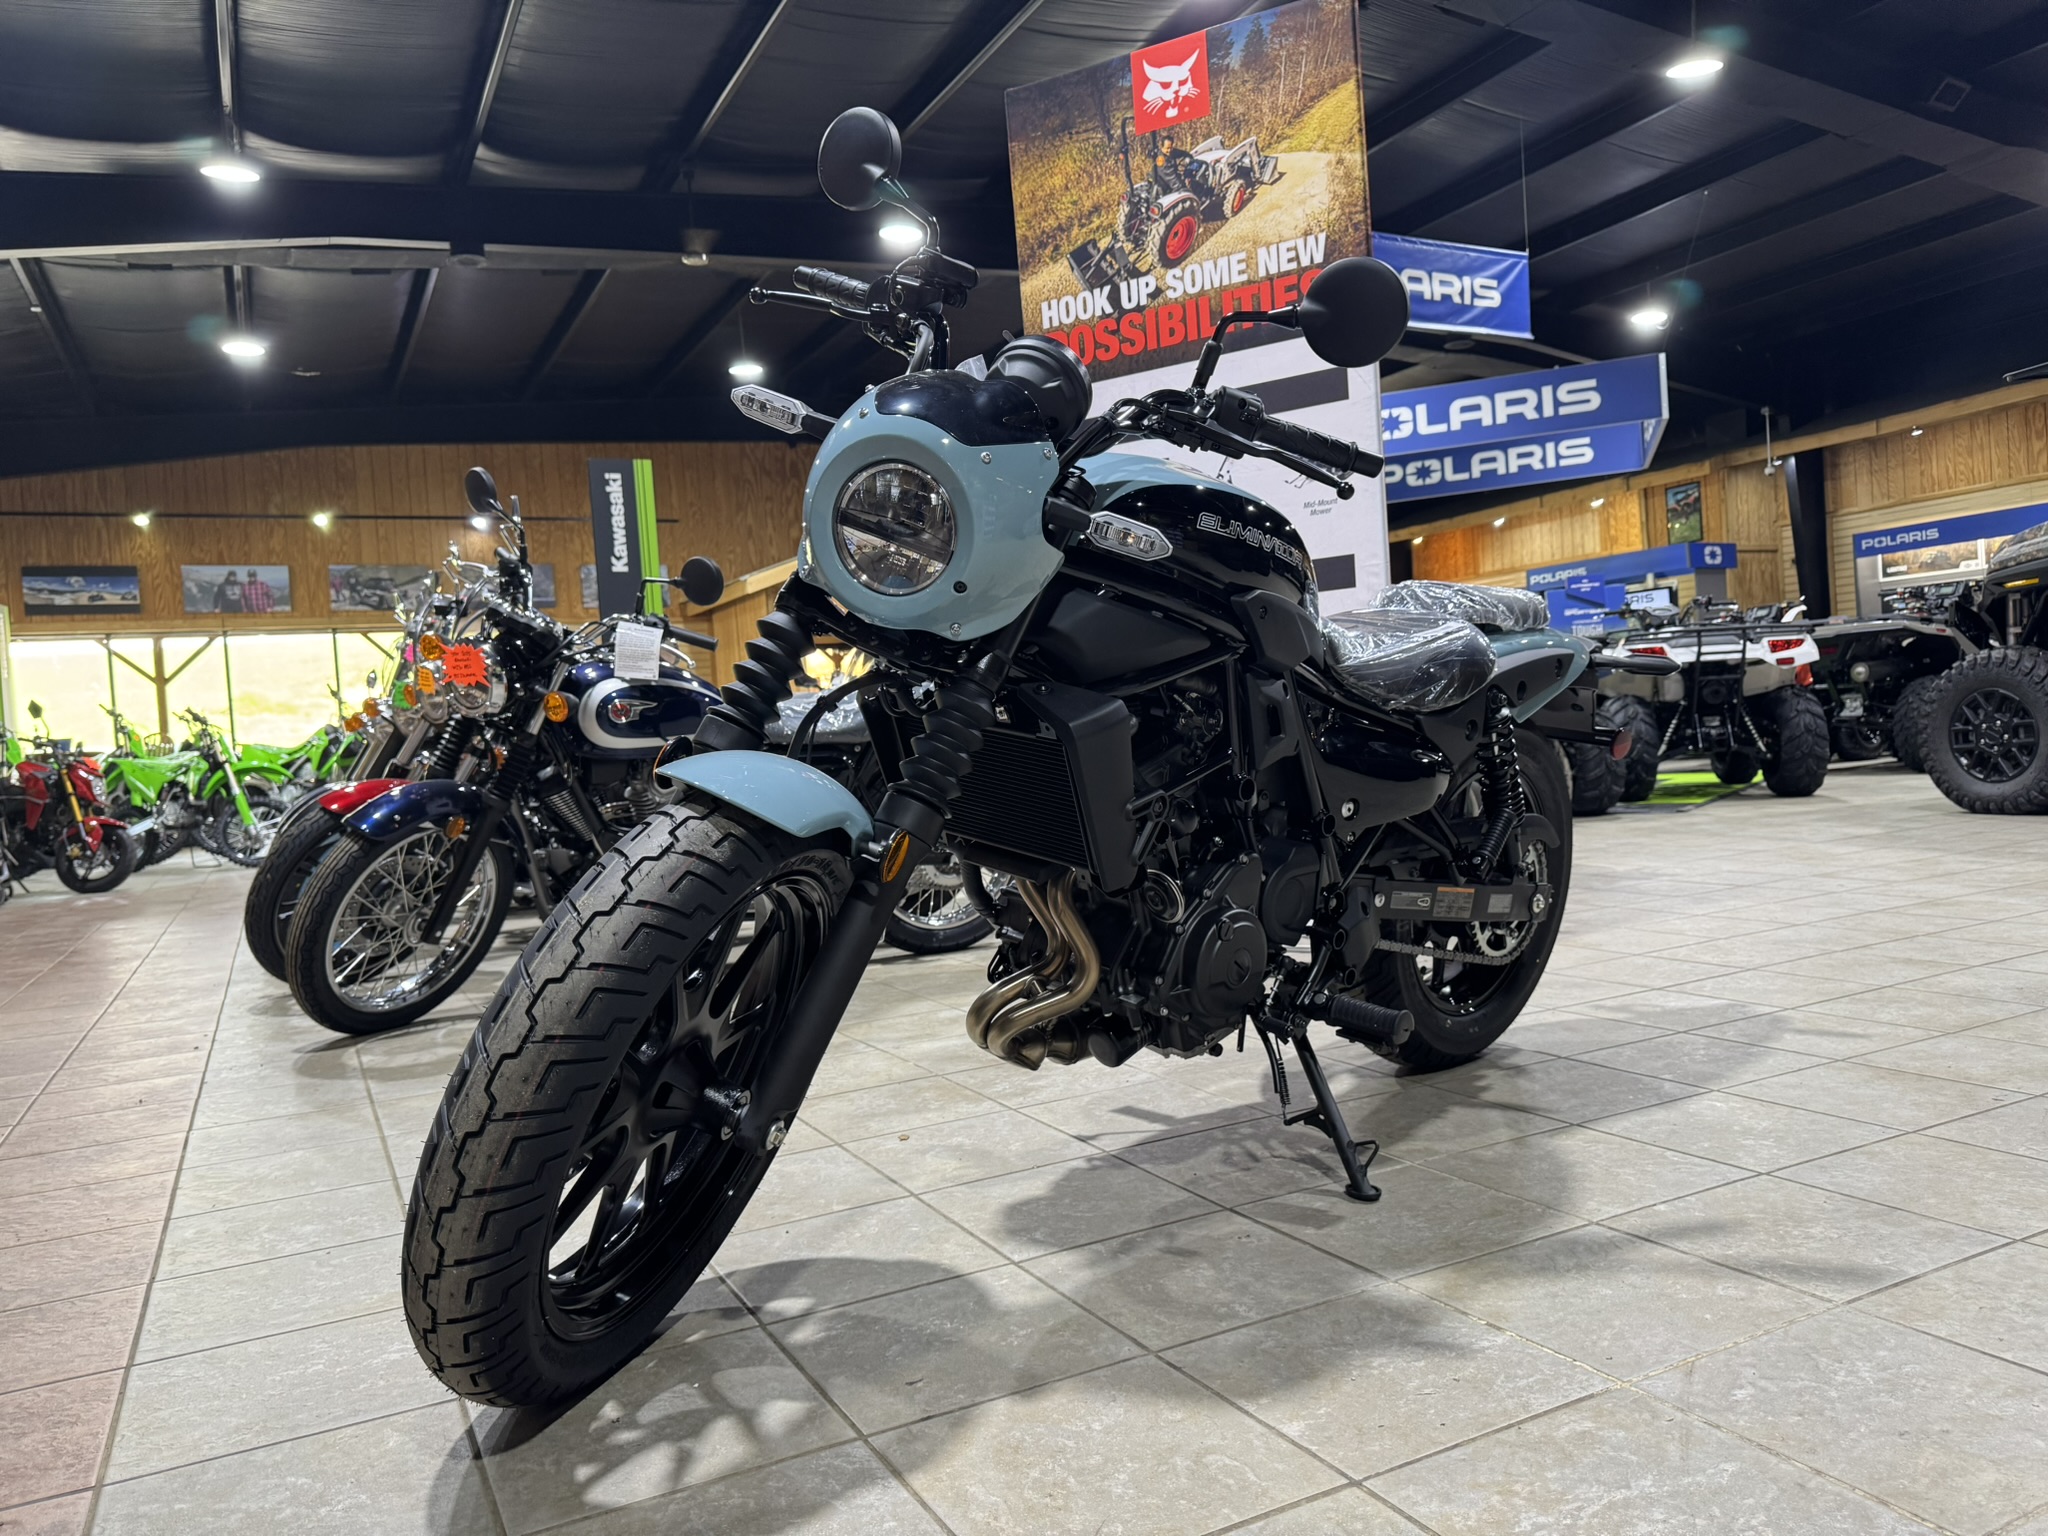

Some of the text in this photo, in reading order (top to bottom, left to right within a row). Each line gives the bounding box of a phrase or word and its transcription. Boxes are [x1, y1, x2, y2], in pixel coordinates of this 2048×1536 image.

[1041, 231, 1327, 329] HOOK UP SOME NEW
[1400, 268, 1502, 308] ARIS
[1381, 378, 1602, 441] OLARIS
[604, 472, 629, 573] Kawasaki
[1303, 498, 1338, 509] Mid-Mount
[1310, 507, 1332, 516] Mower
[1197, 511, 1303, 570] ELIMINATOR
[1861, 527, 1940, 550] POLARIS
